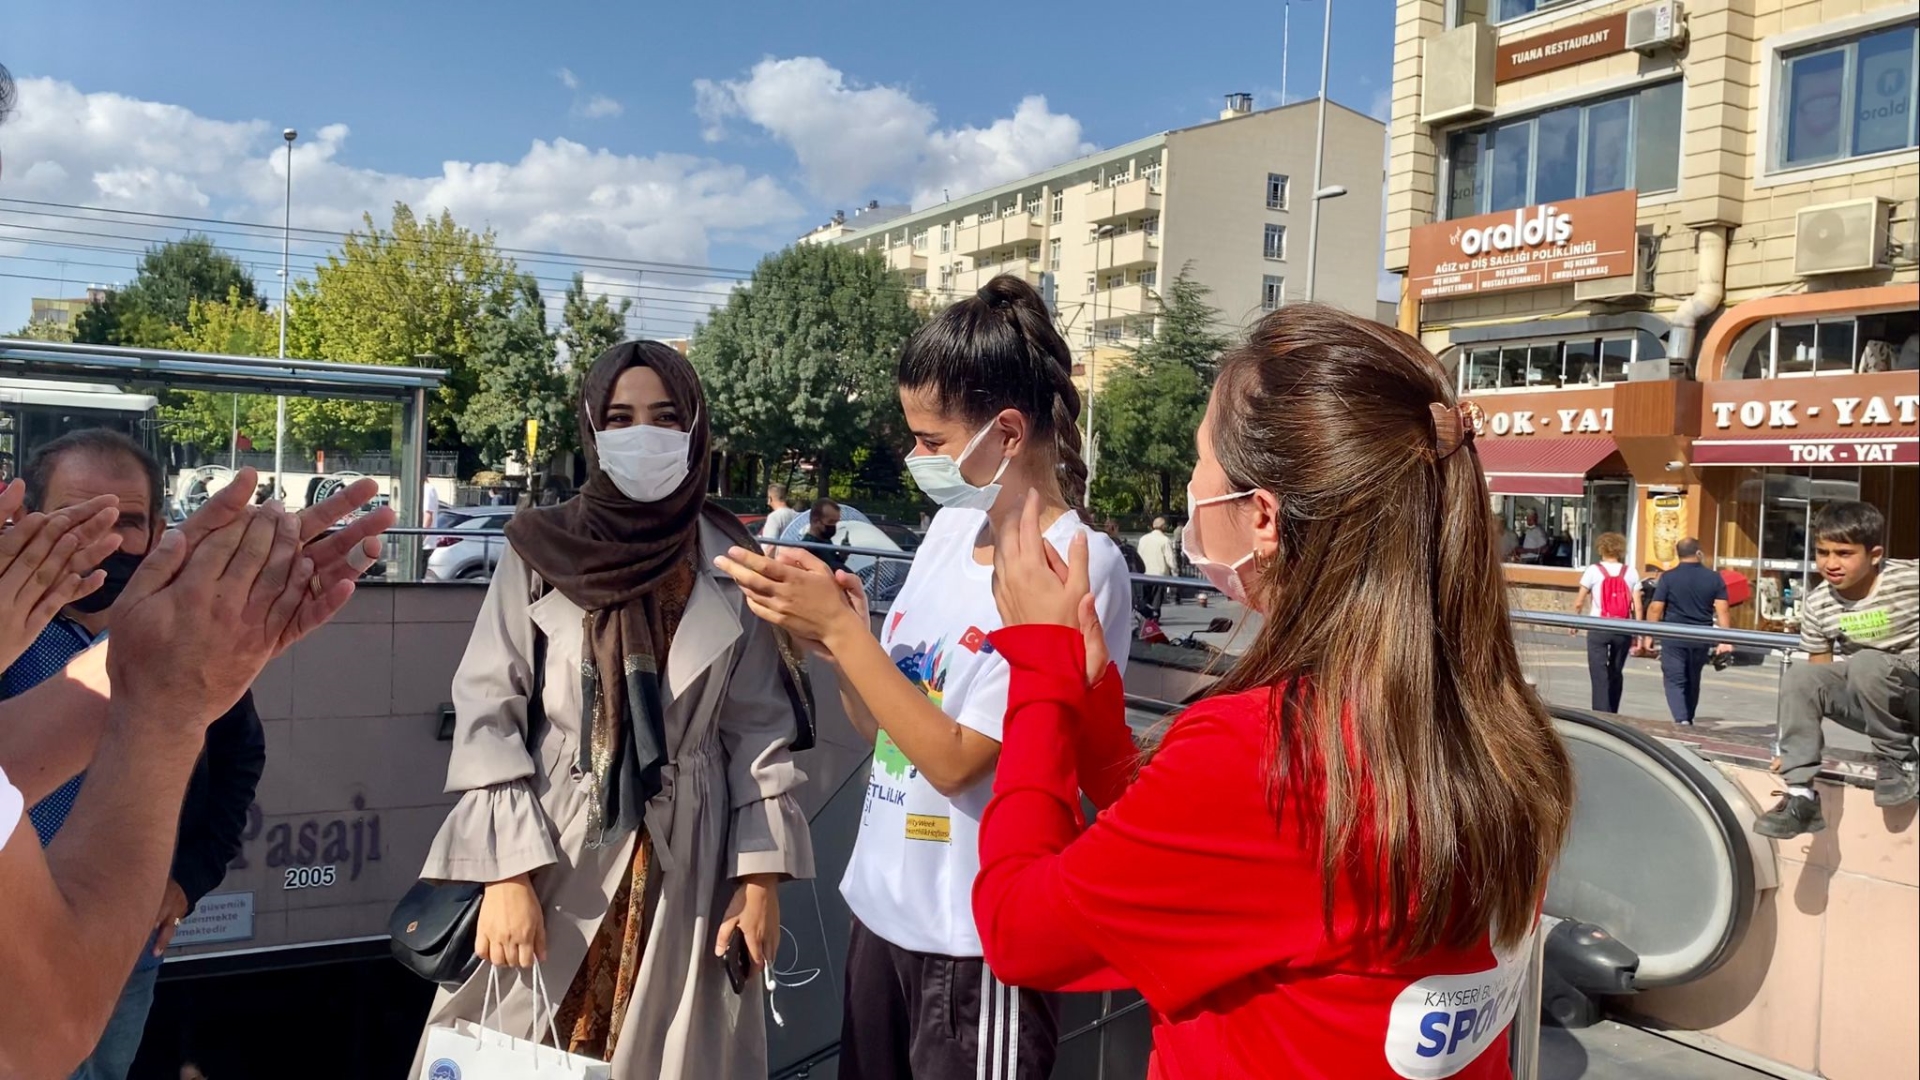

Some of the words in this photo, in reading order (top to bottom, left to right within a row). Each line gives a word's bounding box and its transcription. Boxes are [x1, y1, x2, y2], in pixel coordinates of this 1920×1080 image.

[1511, 47, 1543, 65] TUANA
[1544, 29, 1610, 57] RESTAURANT
[1461, 205, 1573, 255] oraldiş
[1435, 261, 1457, 274] AĞIZ
[1459, 262, 1469, 271] ve
[1472, 256, 1488, 270] DİŞ
[1490, 251, 1530, 267] SAĞLIĞI
[1532, 240, 1596, 260] POLİKLİNİĞİ
[1712, 400, 1799, 428] TOK
[1832, 395, 1919, 425] YAT
[1789, 444, 1835, 462] TOK
[1854, 444, 1897, 462] YAT
[284, 865, 336, 890] 2005
[200, 900, 246, 913] güvenlik
